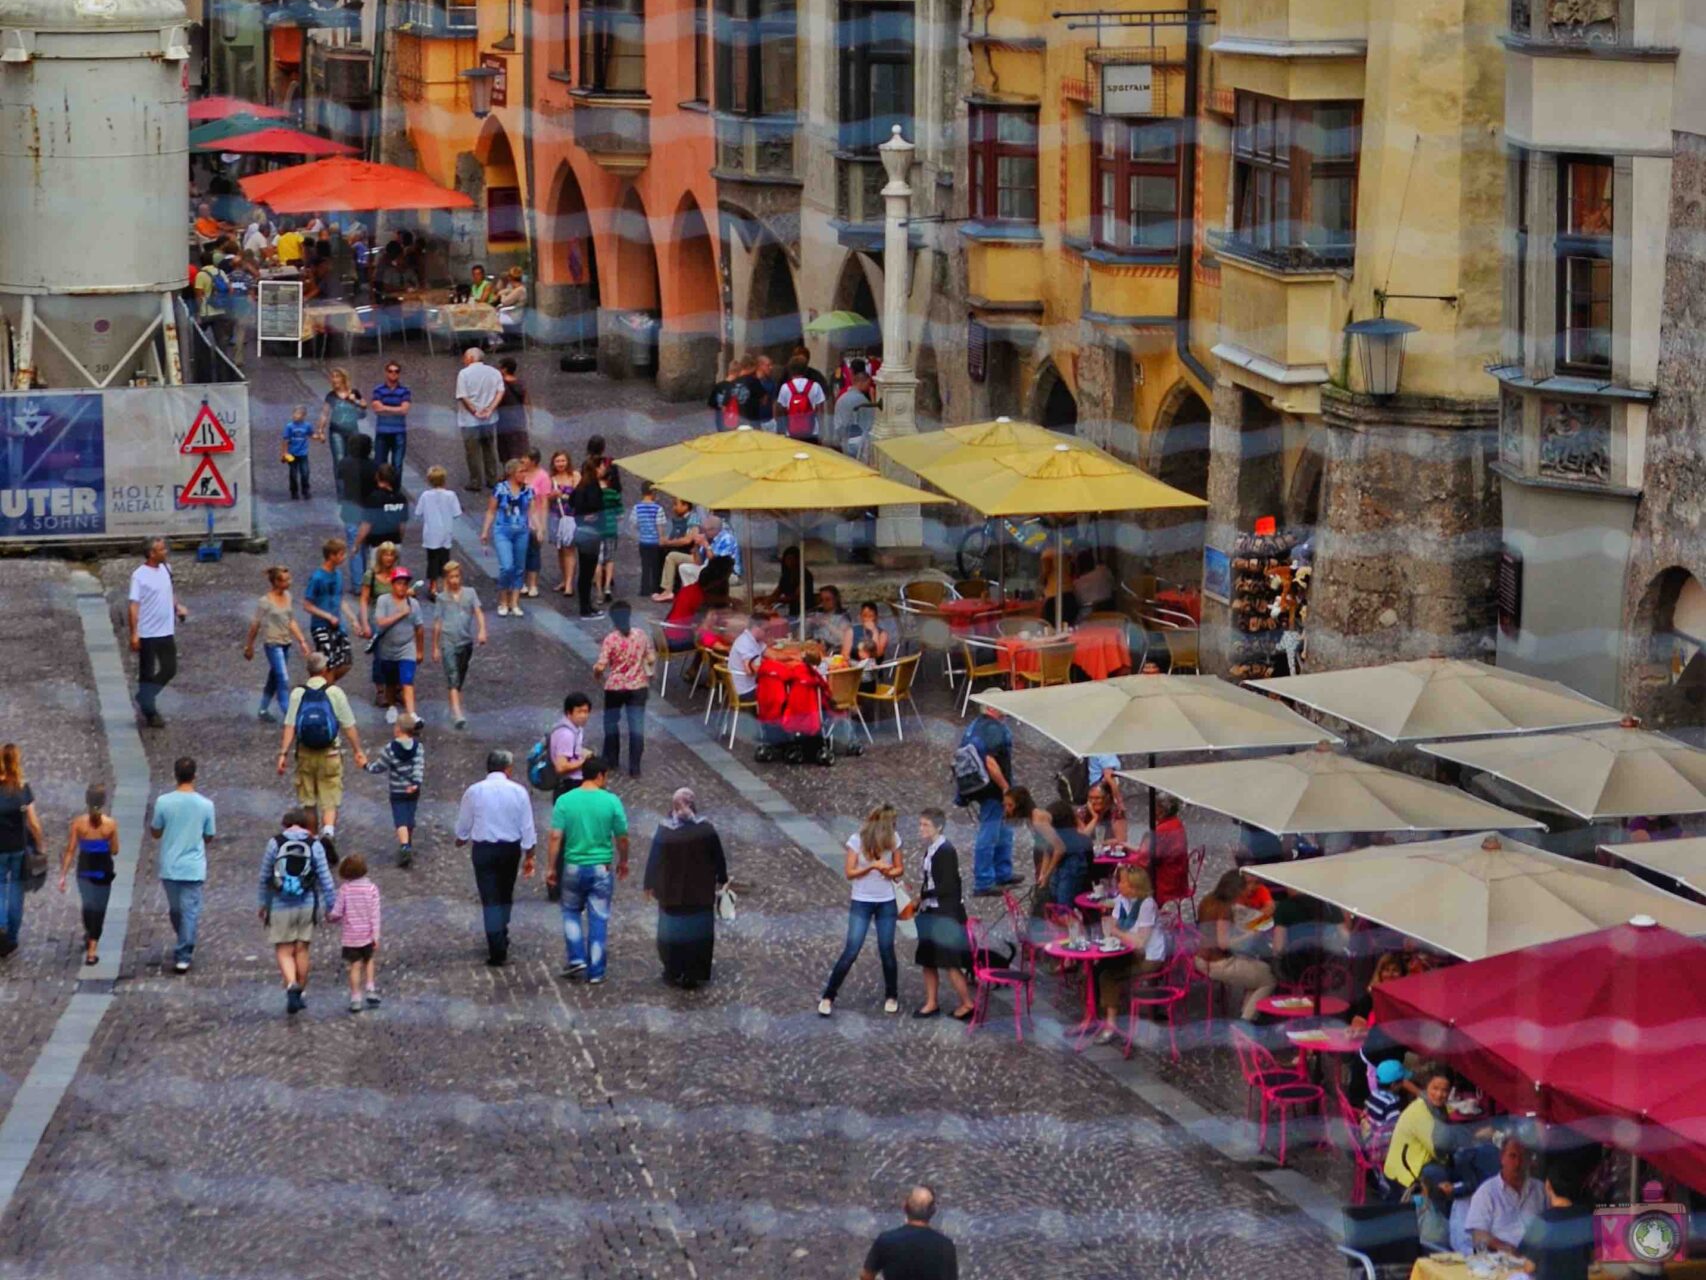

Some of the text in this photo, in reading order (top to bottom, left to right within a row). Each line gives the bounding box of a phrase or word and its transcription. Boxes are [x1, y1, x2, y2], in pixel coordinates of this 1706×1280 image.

[111, 484, 165, 500] HOLZ
[1, 487, 98, 518] UTER
[111, 499, 165, 513] METALL
